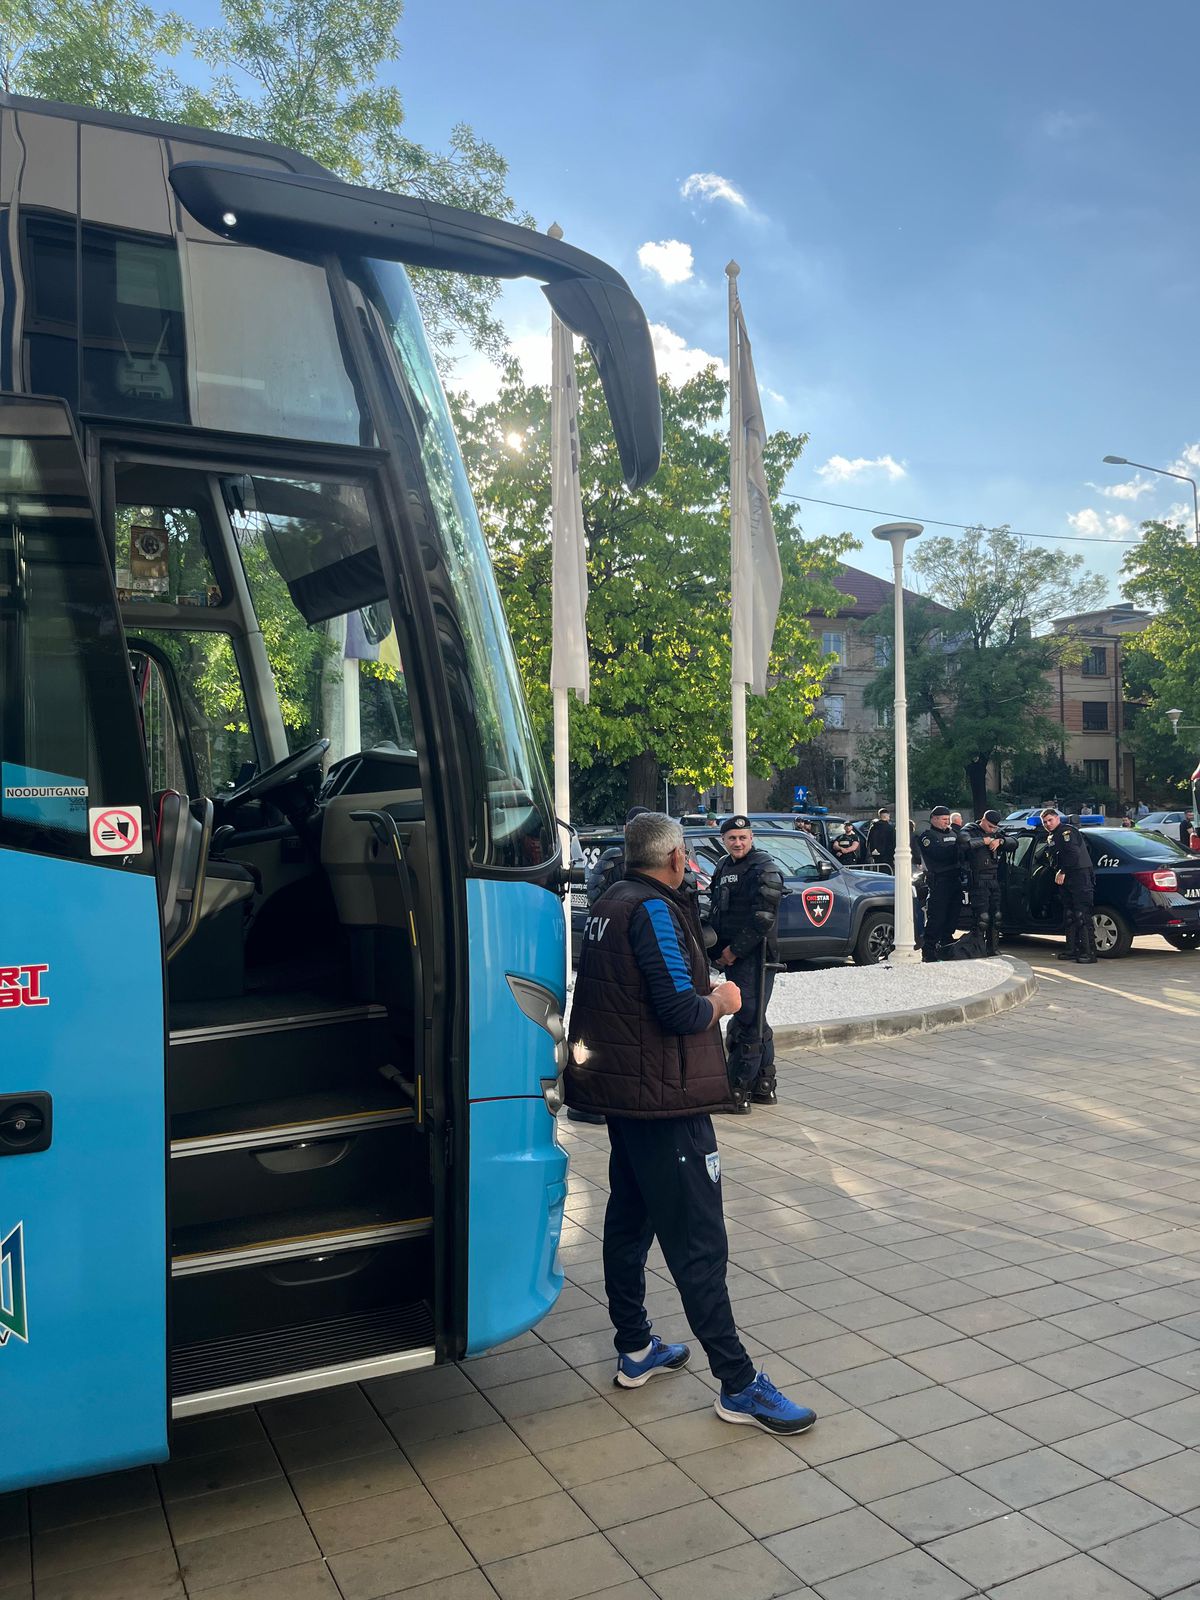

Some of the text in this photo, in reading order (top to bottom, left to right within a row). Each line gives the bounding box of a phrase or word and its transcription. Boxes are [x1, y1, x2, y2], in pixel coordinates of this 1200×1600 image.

[6, 787, 86, 797] NOODUITGANG
[1104, 859, 1120, 867] 112
[583, 916, 611, 942] FCV
